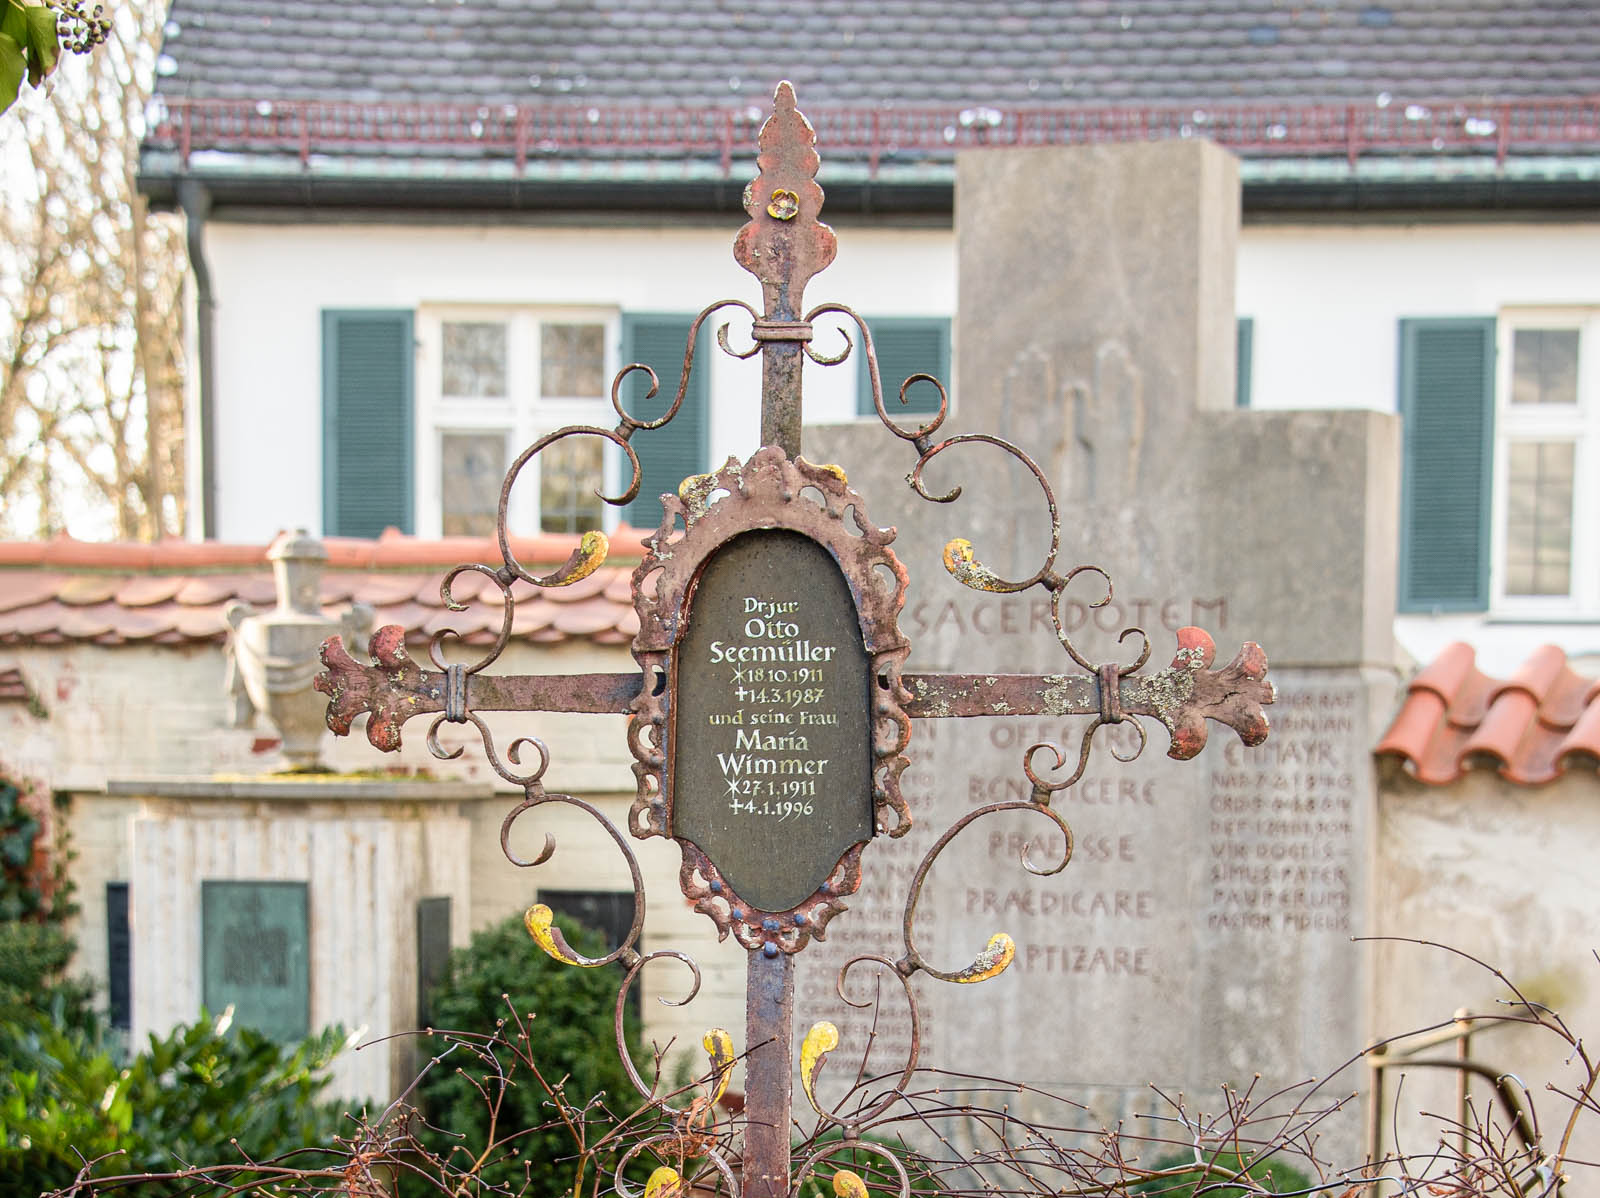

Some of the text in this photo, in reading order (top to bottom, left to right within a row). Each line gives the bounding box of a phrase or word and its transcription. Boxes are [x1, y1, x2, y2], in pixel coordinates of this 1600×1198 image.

[744, 618, 799, 639] Otto
[709, 640, 837, 663] Seemüller
[709, 709, 837, 725] und seine Frau
[735, 728, 809, 751] Maria
[717, 752, 829, 776] Wimmer
